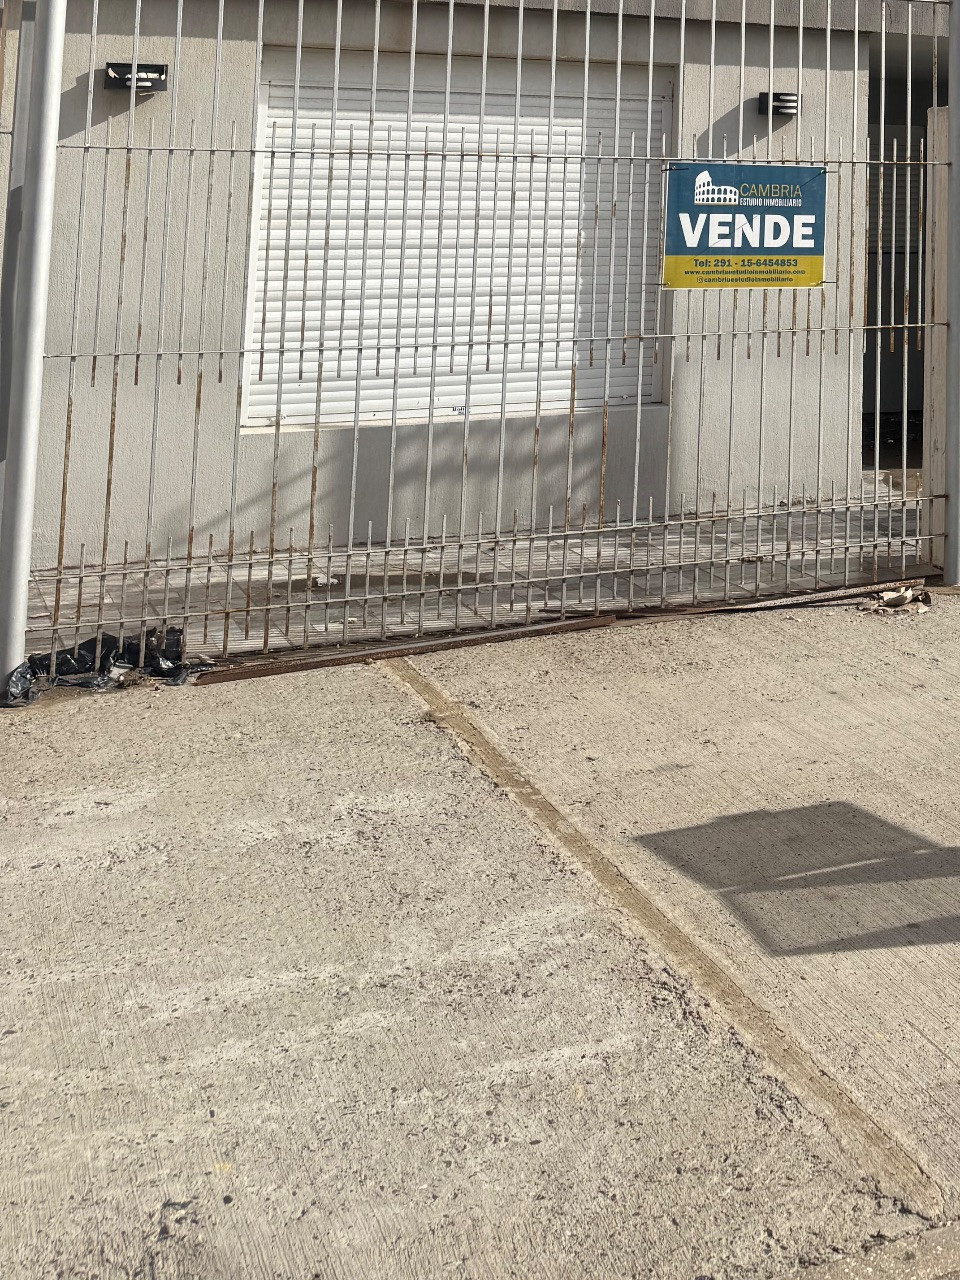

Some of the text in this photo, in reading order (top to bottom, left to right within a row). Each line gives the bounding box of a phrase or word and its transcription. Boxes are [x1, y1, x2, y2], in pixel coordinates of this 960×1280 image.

[740, 183, 802, 197] CAMBRIA
[740, 198, 802, 207] ESTUDIO INMOBILIARIO
[678, 213, 816, 248] VENDE
[694, 259, 711, 267] Tel:
[714, 259, 732, 267] 291
[741, 259, 798, 267] 15-6454853
